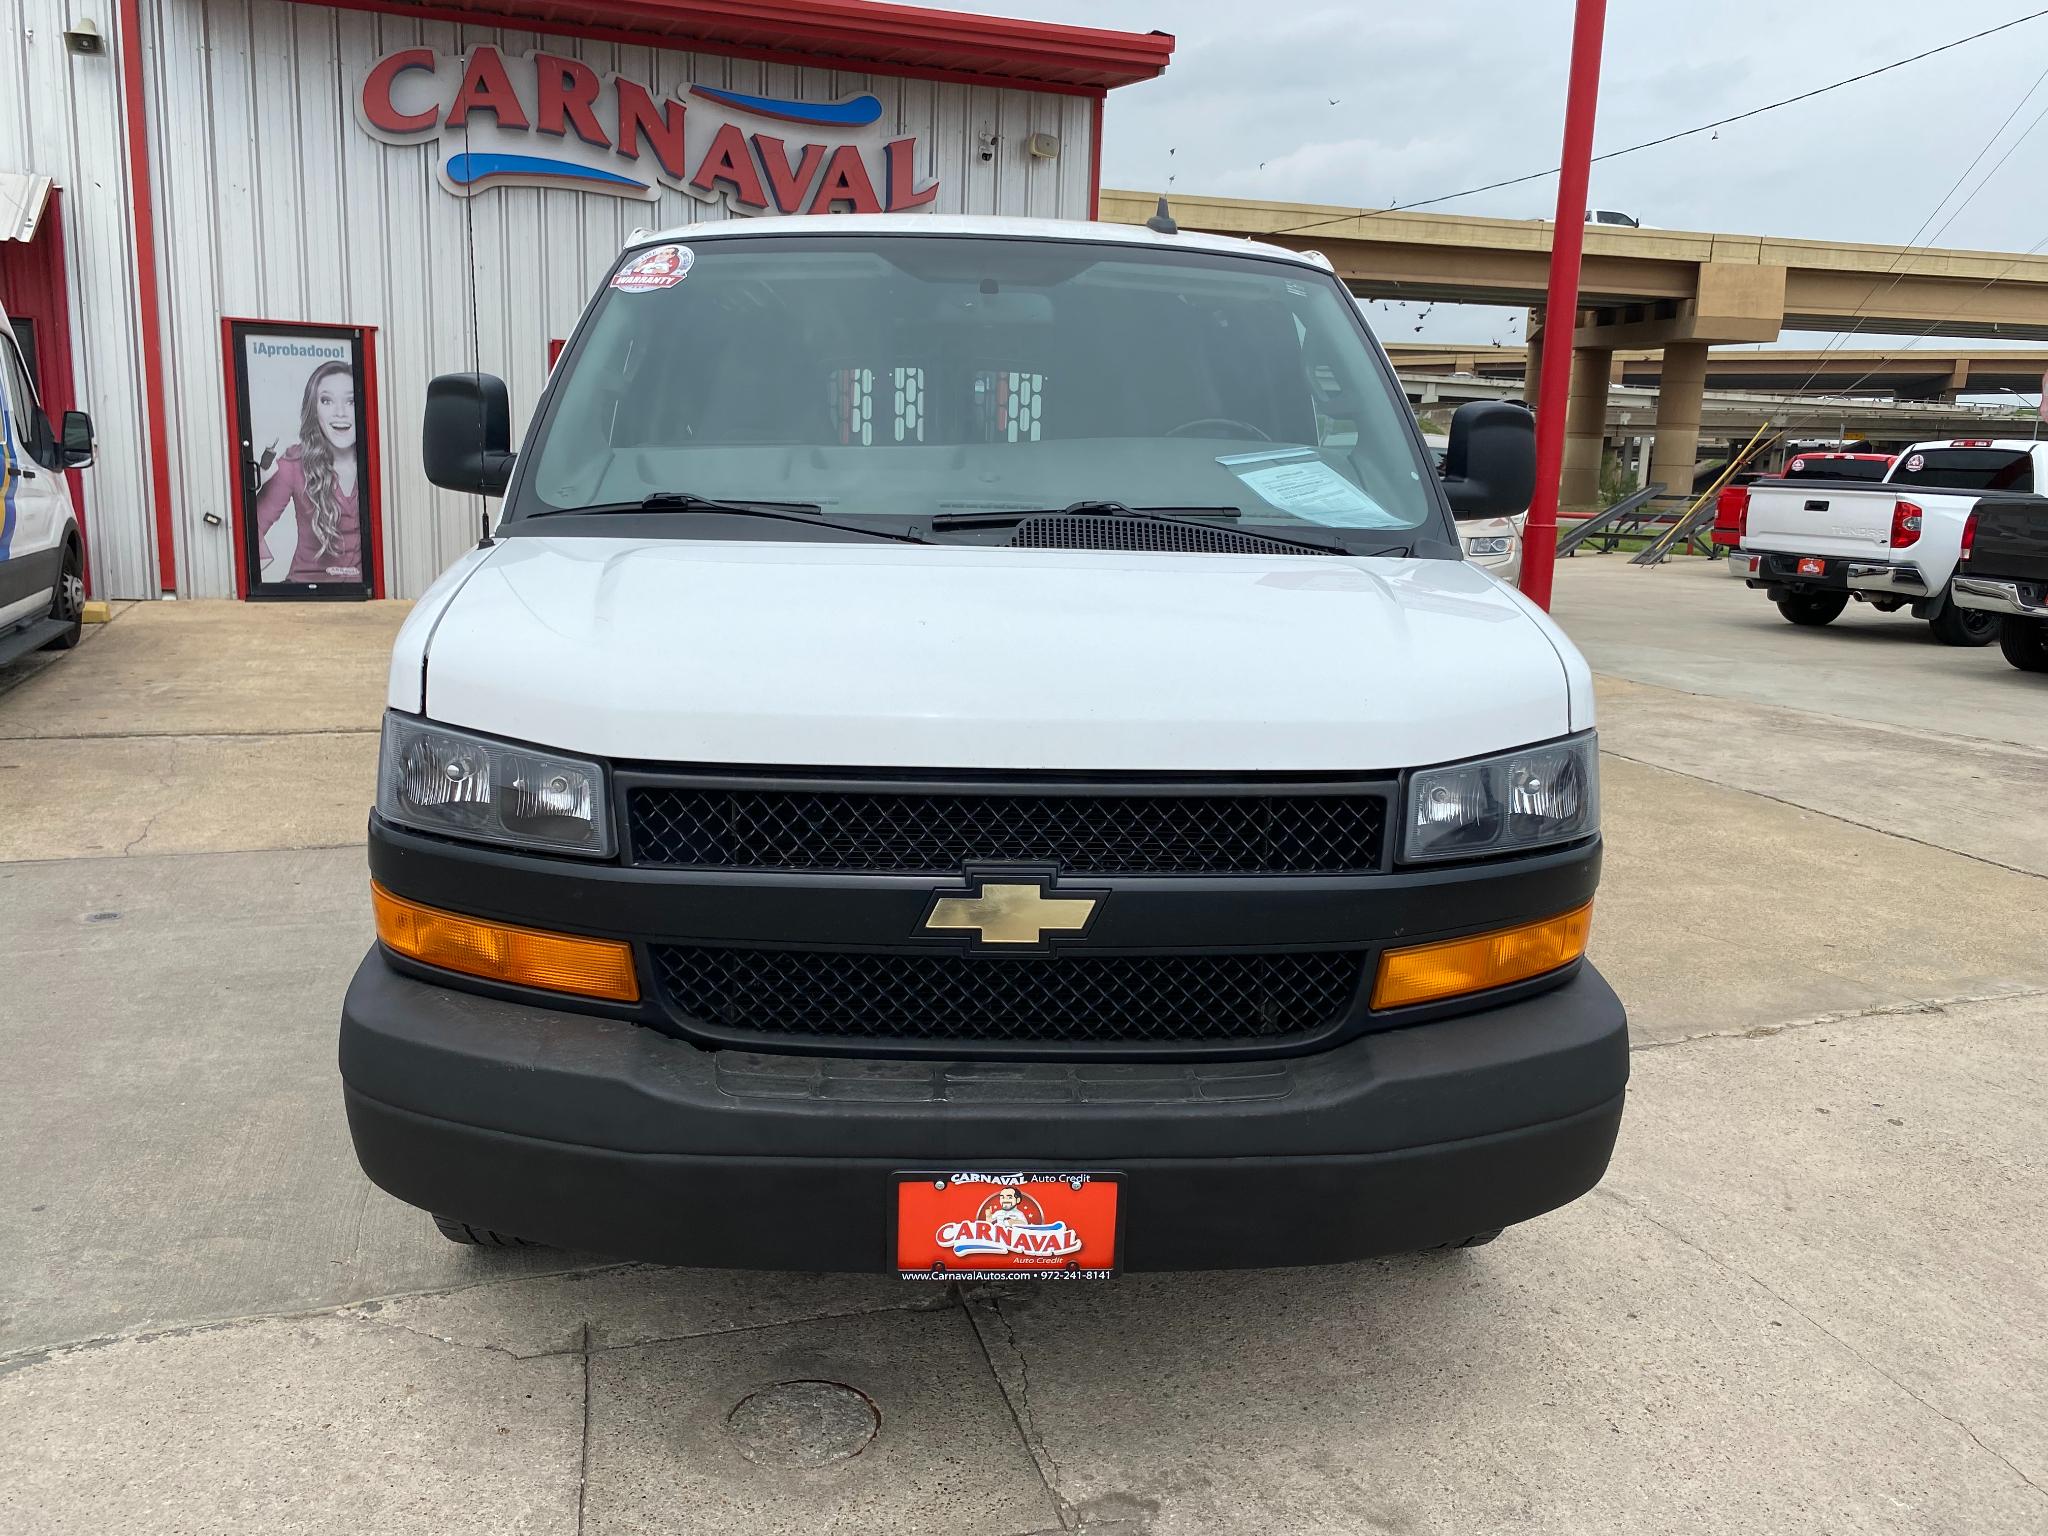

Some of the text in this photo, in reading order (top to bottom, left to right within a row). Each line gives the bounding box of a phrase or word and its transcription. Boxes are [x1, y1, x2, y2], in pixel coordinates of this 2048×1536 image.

[363, 47, 939, 214] CARNAVAL
[616, 276, 675, 285] WARRANTY
[1831, 525, 1887, 539] TUNDRA
[951, 1173, 1090, 1185] CARNAVAL Auto Credit
[937, 1222, 1079, 1253] CARNAVAL
[902, 1271, 1110, 1281] www.CarnavalAutos.com 972-241-8141
